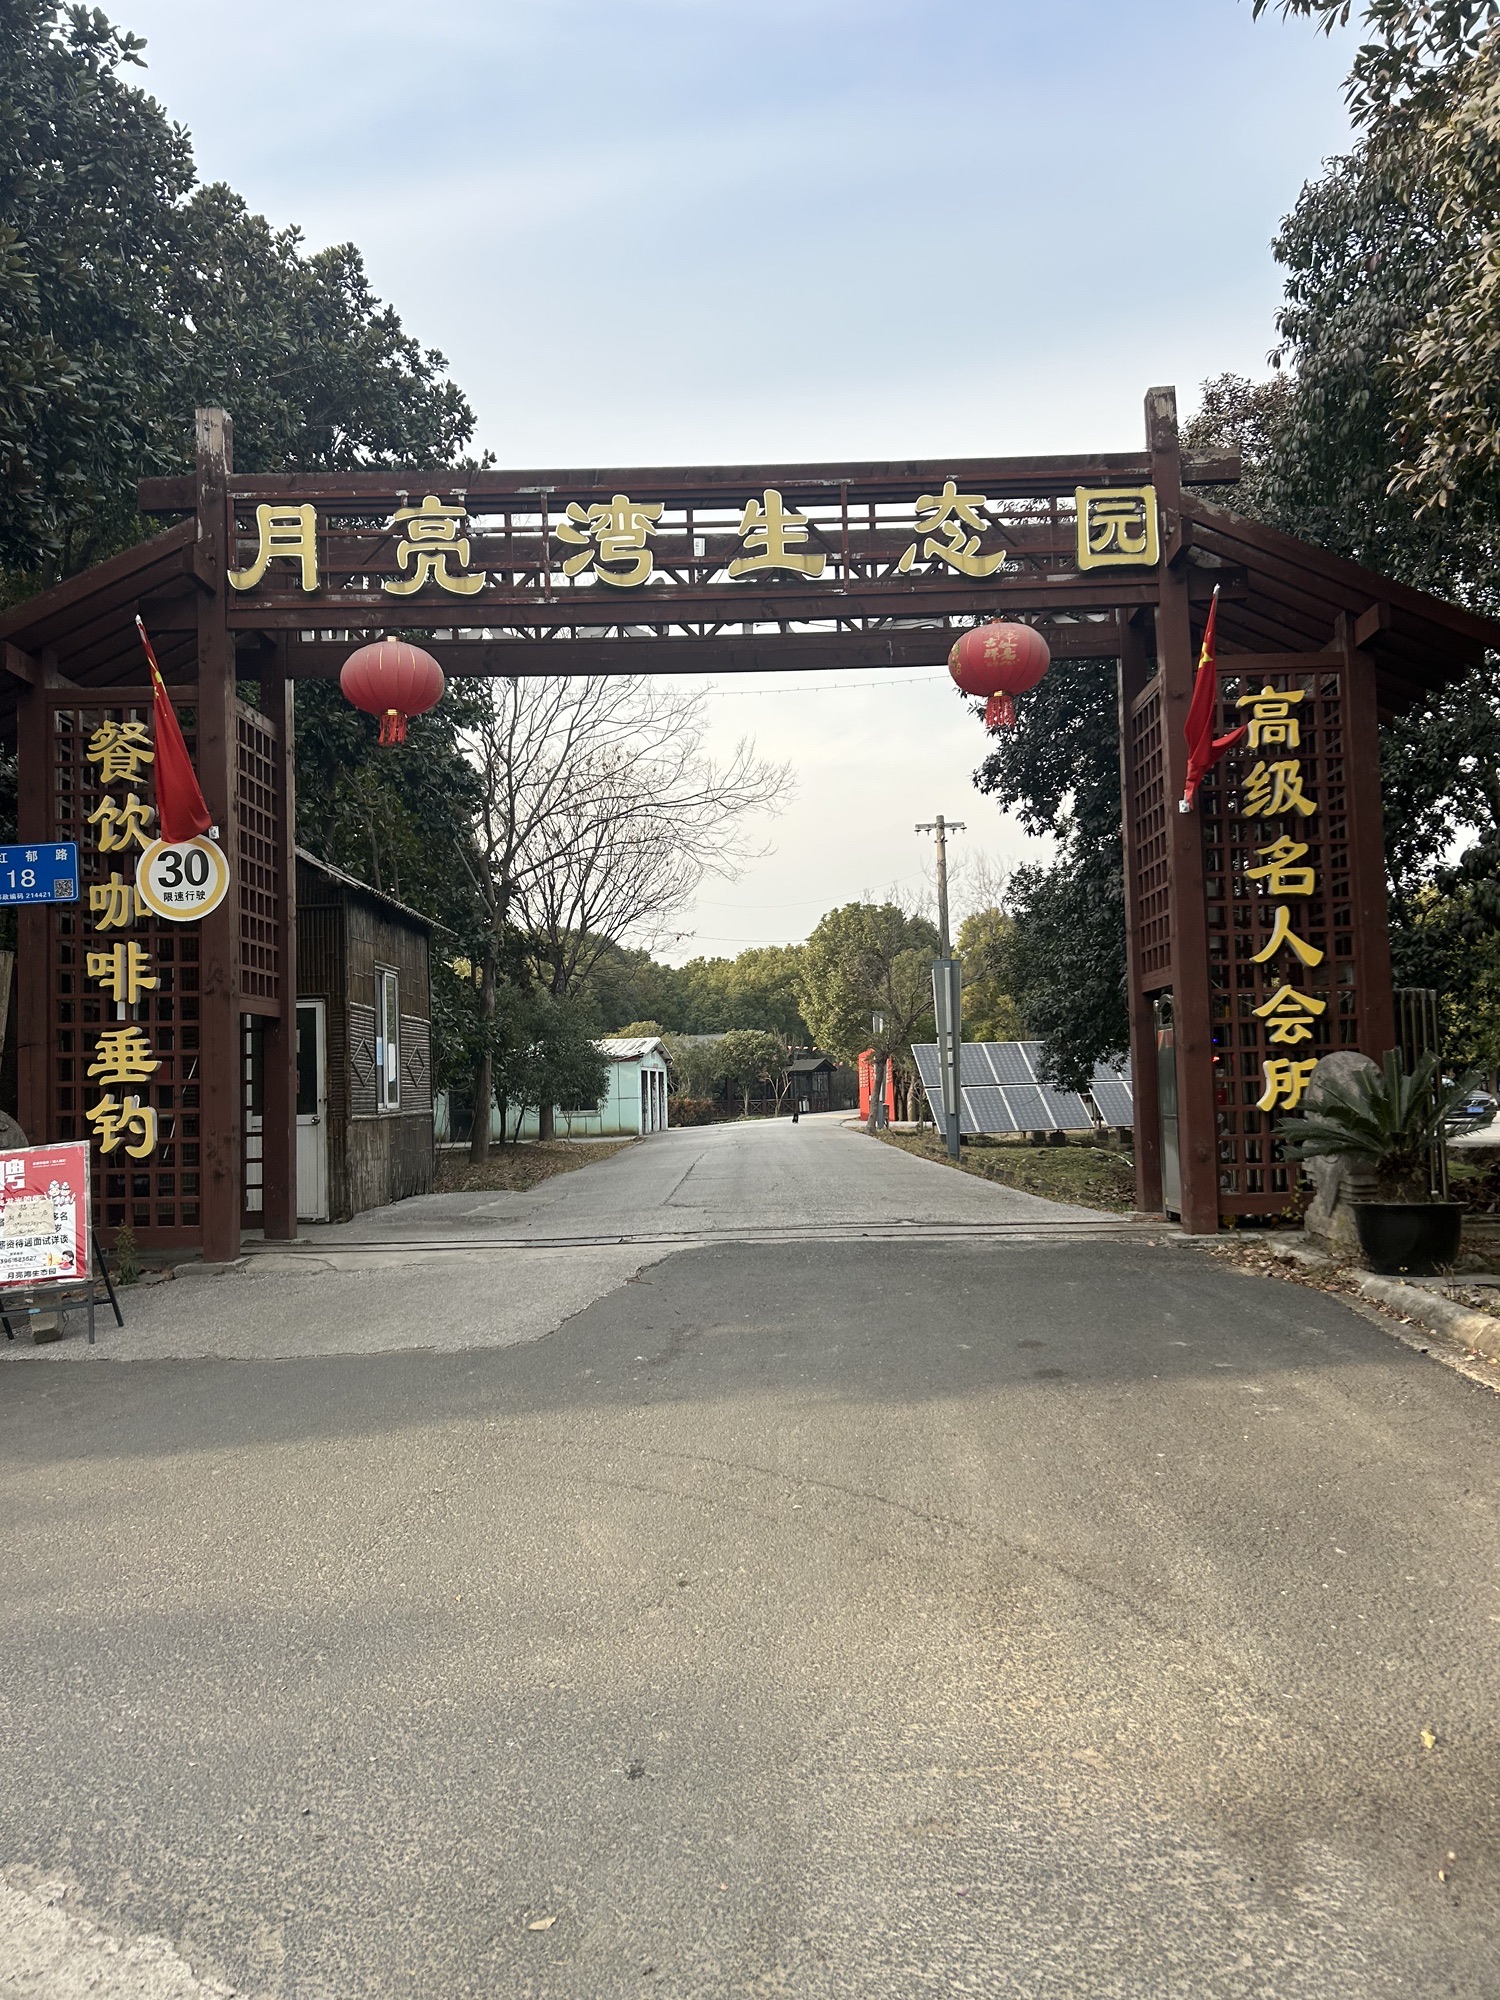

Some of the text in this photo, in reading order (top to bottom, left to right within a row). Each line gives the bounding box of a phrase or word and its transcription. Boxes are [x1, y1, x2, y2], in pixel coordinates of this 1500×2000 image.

[227, 480, 1160, 596] 月亮湾生态园
[6, 868, 36, 888] 18
[157, 848, 210, 888] 30
[163, 889, 206, 902] 限速行驶
[1235, 684, 1327, 1112] 高级名人会所
[86, 719, 162, 1159] 餐饮咖啡垂钓
[7, 1267, 57, 1279] 月亮湾生态园
